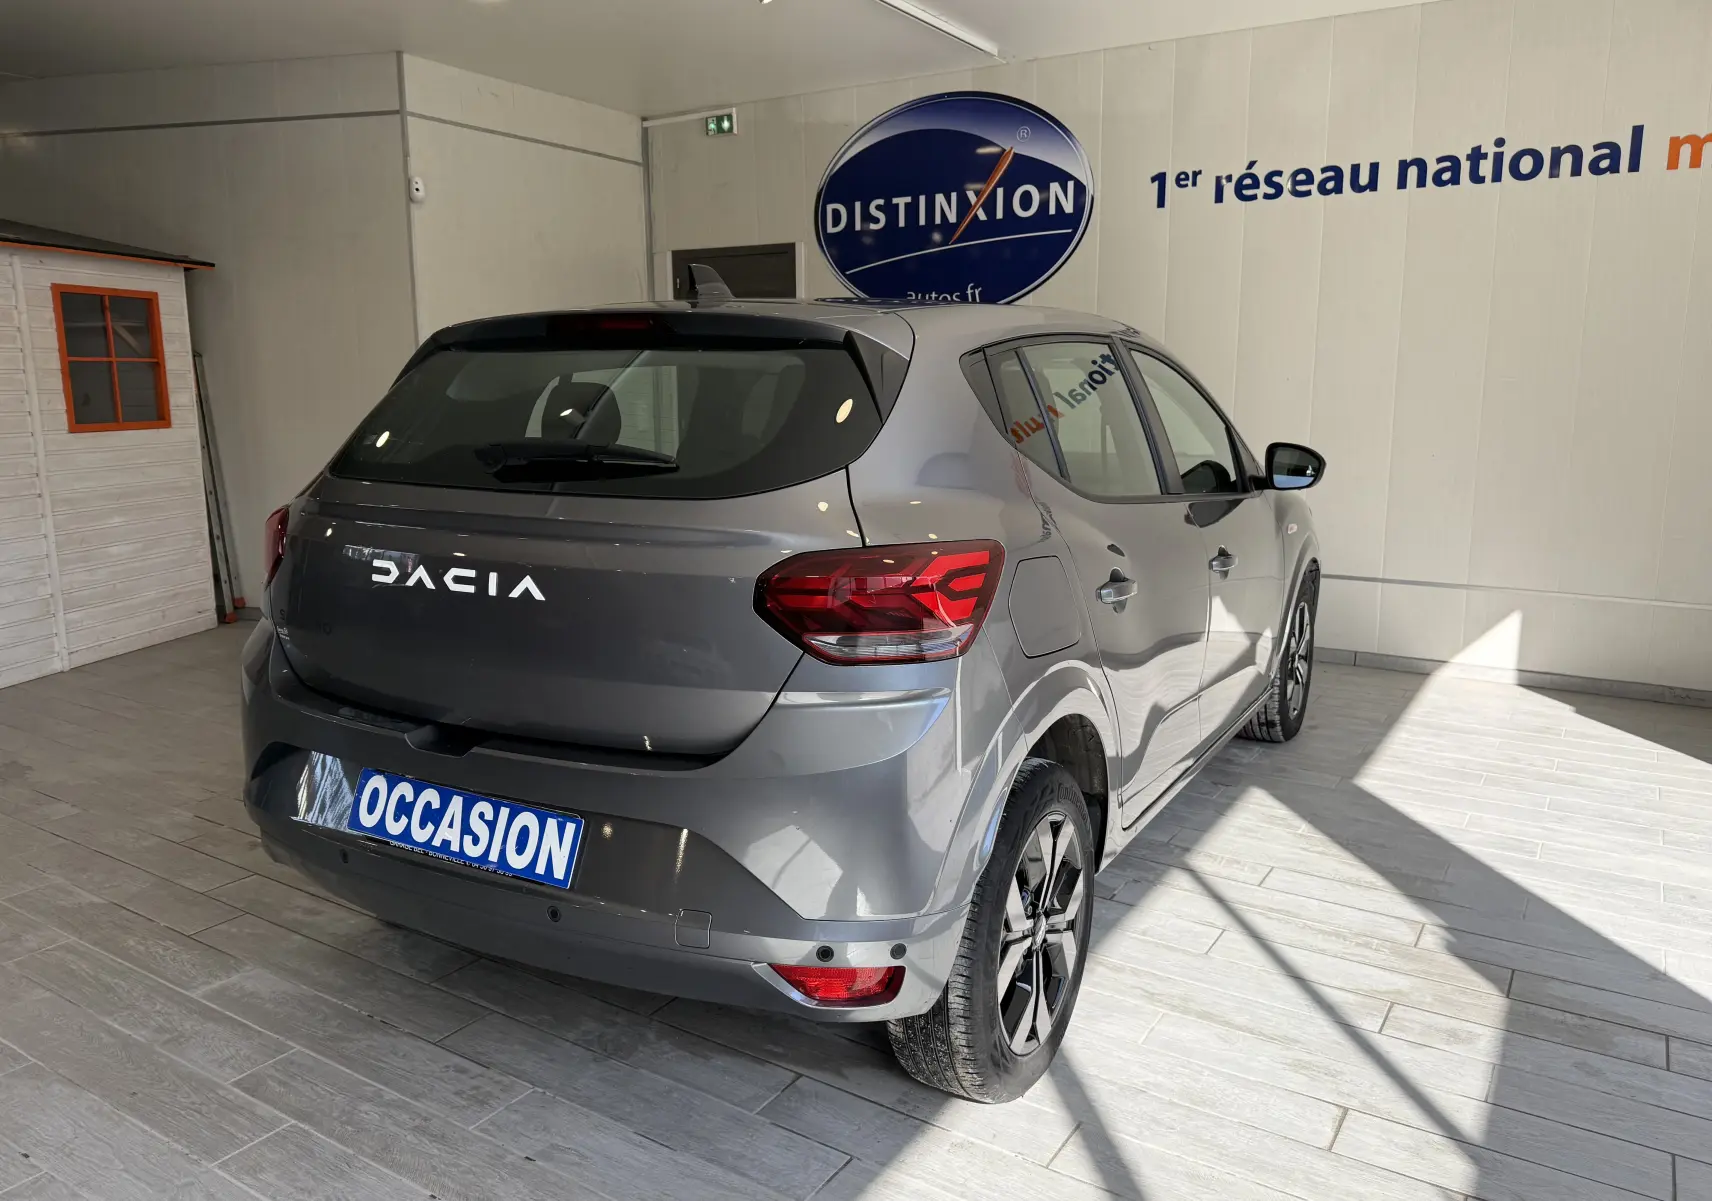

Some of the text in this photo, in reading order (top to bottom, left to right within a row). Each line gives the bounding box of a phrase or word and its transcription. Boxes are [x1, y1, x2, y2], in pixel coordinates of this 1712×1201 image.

[1149, 166, 1202, 209] 1er
[1213, 160, 1380, 205] réseau
[1396, 124, 1645, 190] national
[825, 180, 1075, 234] DISTINXION
[371, 559, 546, 601] DACIA
[358, 774, 577, 881] OCCASION
